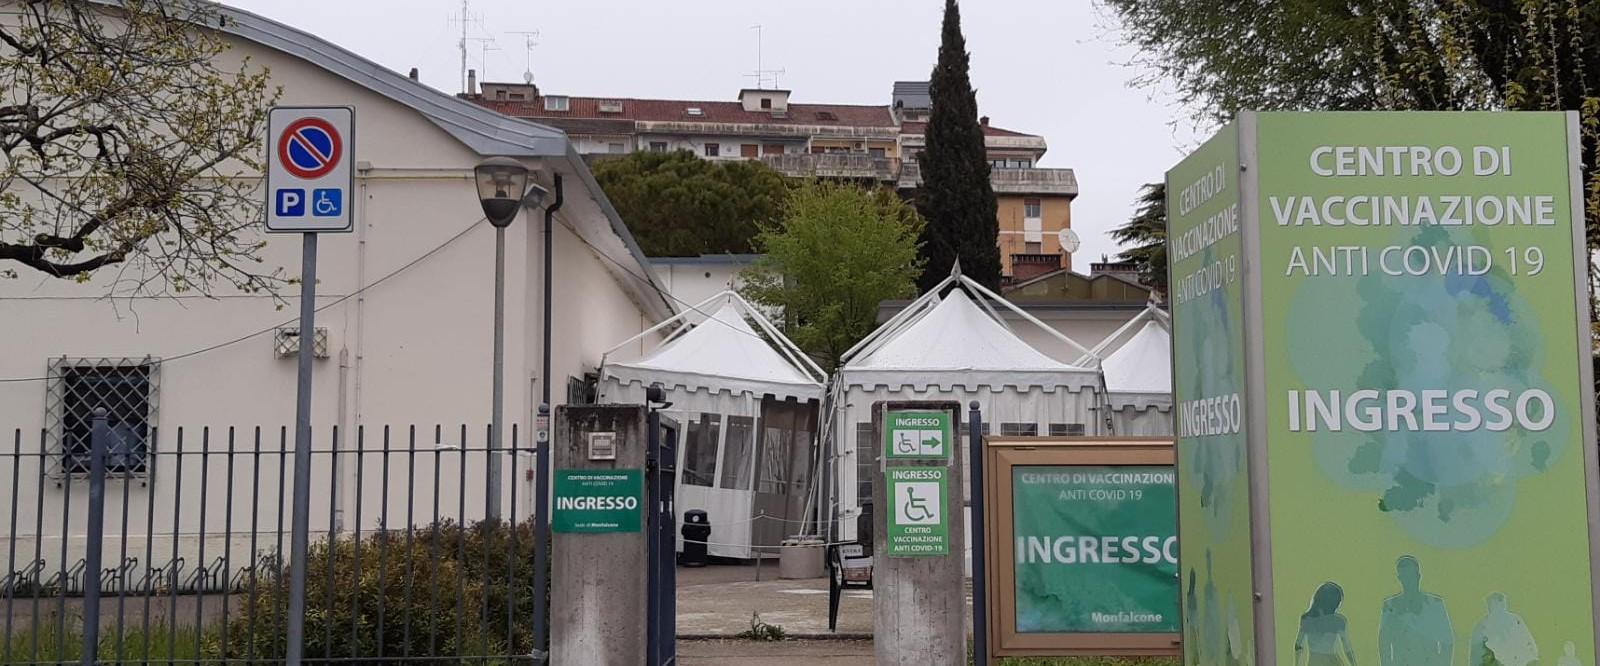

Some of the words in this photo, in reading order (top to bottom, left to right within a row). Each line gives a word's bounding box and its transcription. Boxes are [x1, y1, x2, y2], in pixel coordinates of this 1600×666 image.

[1309, 145, 1463, 177] CENTRO
[1472, 145, 1511, 177] DI
[282, 191, 300, 214] P
[1180, 171, 1214, 217] CENTRO
[1215, 162, 1225, 193] DI
[1269, 195, 1555, 226] VACCINAZIONE
[1172, 203, 1238, 264] VACCINAZIONE
[1285, 245, 1368, 276] ANTI
[1379, 245, 1492, 276] COVID
[1504, 245, 1545, 276] 19
[1177, 274, 1195, 304] ANTI
[1195, 261, 1222, 297] COVID
[1225, 255, 1235, 285] 19
[895, 418, 940, 427] INGRESSO
[1180, 393, 1240, 437] INGRESSO
[1287, 388, 1555, 432] INGRESSO
[892, 470, 942, 479] INGRESSO
[1021, 473, 1071, 484] CENTRO
[1073, 473, 1086, 484] DI
[1088, 473, 1175, 484] VACCINAZION
[556, 496, 638, 510] INGRESSO
[1059, 490, 1086, 500] ANTI
[1088, 489, 1126, 501] COVID
[1129, 489, 1143, 501] 19
[1091, 611, 1163, 623] Monfalcone
